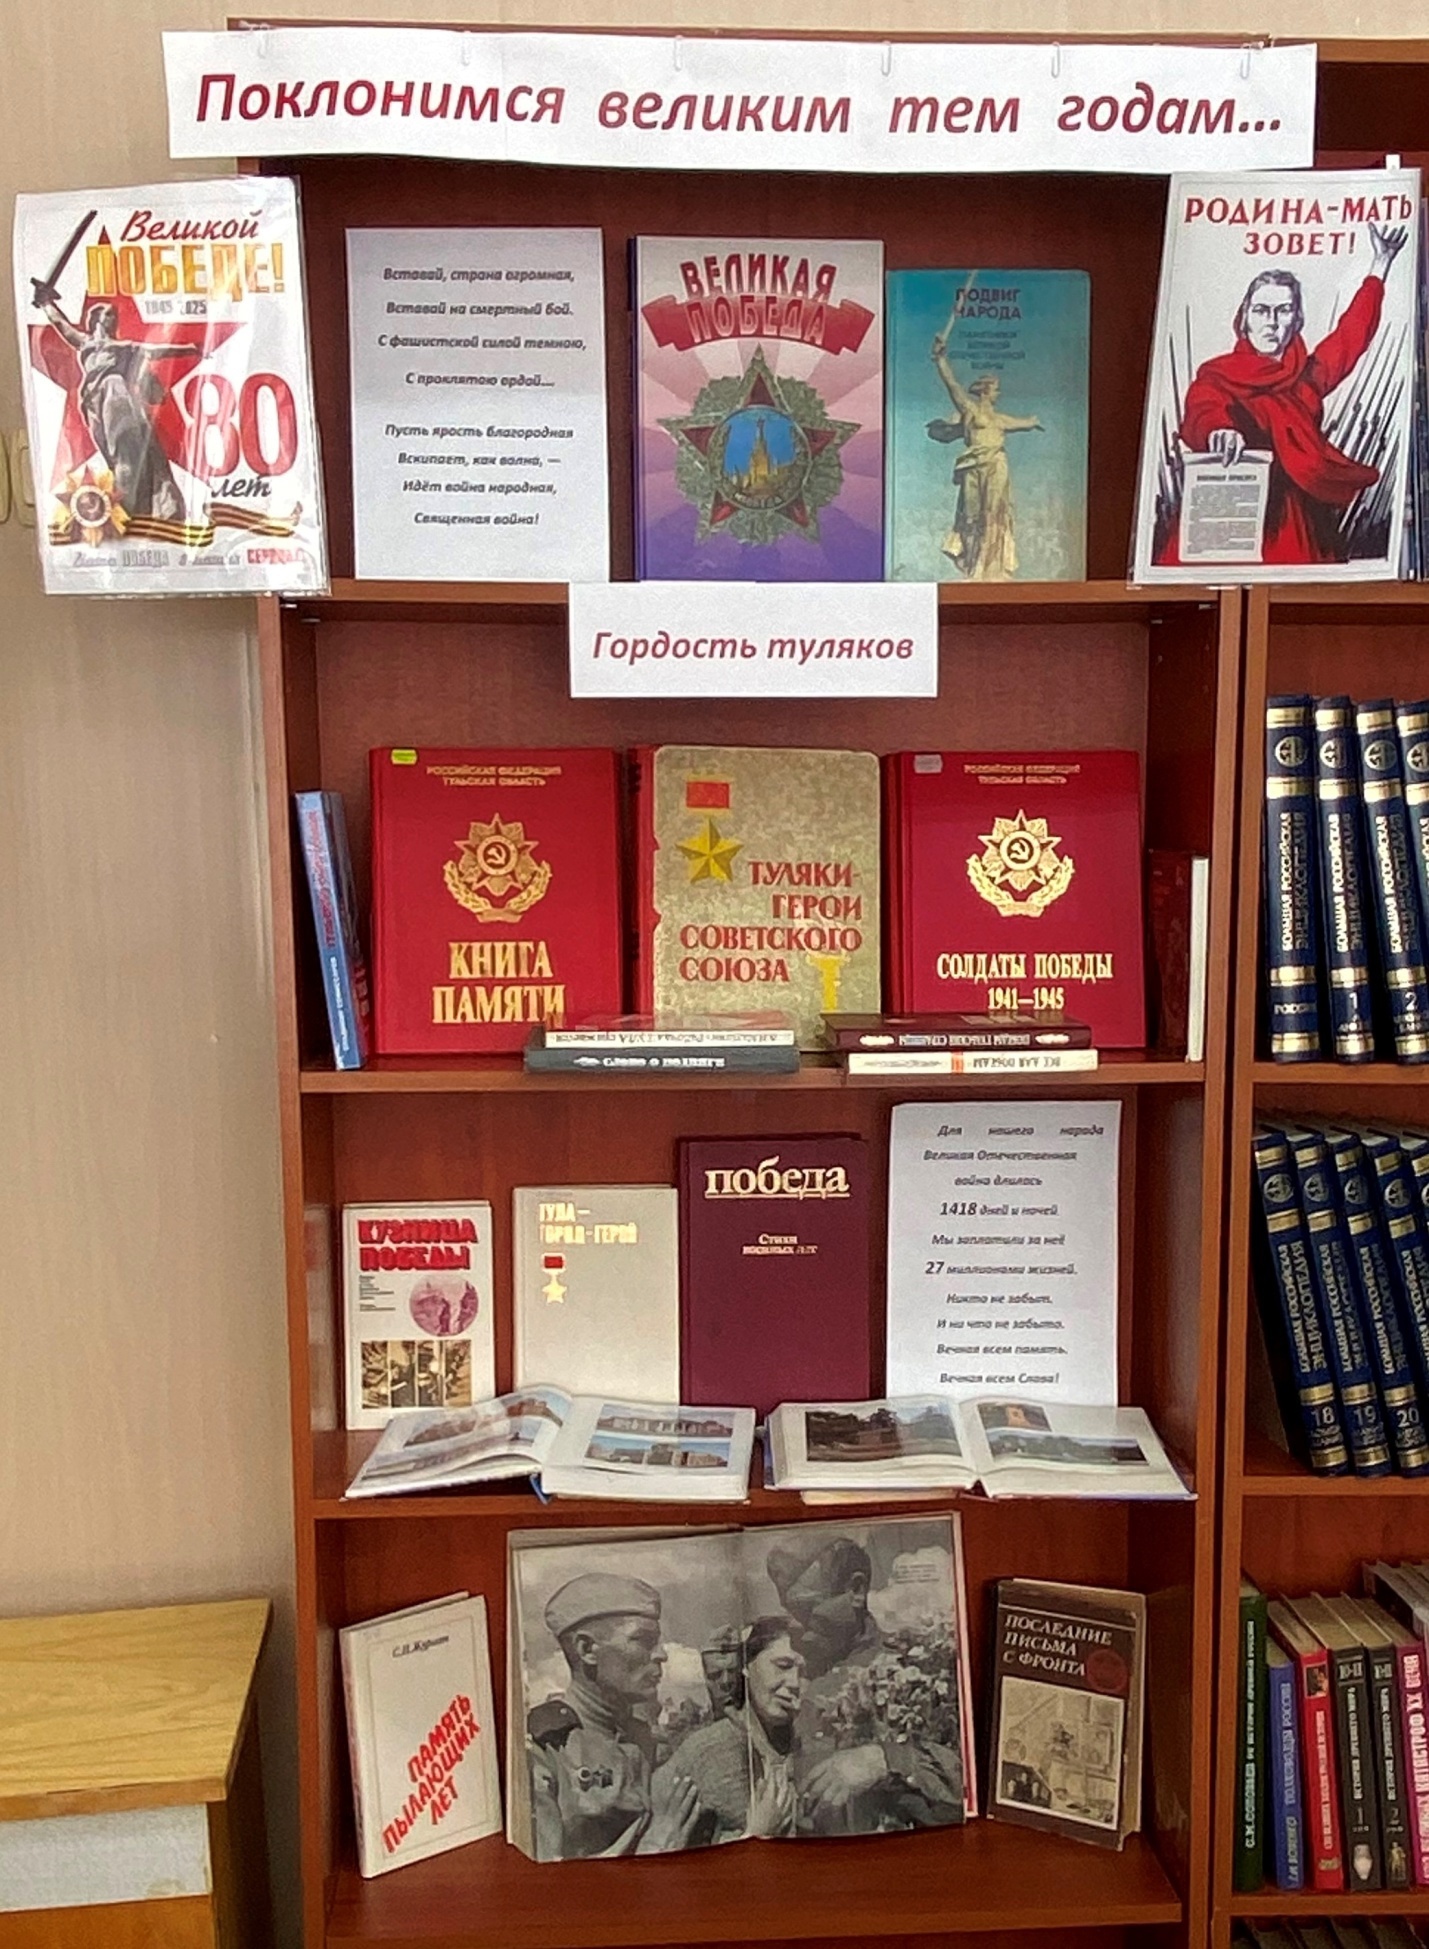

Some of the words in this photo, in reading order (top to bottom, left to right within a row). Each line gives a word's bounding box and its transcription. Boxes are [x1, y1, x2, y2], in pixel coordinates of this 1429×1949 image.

[196, 73, 565, 124] Поклонимся
[598, 90, 850, 134] великим
[888, 95, 1021, 133] тем
[1056, 81, 1283, 135] годам...
[1184, 194, 1413, 226] РОДИНА-МАТЬ
[120, 209, 263, 242] Великой
[1243, 232, 1356, 255] ЗОВЕТ!
[85, 243, 285, 301] ПОБЕДЕ!
[383, 268, 447, 282] Вставай,
[450, 270, 501, 283] страна
[505, 270, 575, 283] огромная,
[680, 253, 837, 303] ВЕЛИКАЯ
[956, 288, 1021, 304] ПОДВИГ
[386, 302, 446, 315] Вставай
[450, 305, 466, 315] на
[469, 303, 542, 317] смертный
[545, 302, 574, 315] бой.
[686, 295, 826, 345] ПОБЕДА
[378, 334, 387, 346] С
[389, 334, 479, 349] фашистской
[482, 336, 521, 348] силой
[406, 372, 415, 384] С
[417, 373, 498, 387] проклятою
[183, 371, 297, 477] 80
[385, 424, 429, 438] Пусть
[432, 426, 483, 438] ярость
[486, 426, 574, 440] благородная
[398, 453, 469, 467] Вскипает,
[472, 455, 496, 466] как
[499, 456, 543, 467] волна,
[211, 477, 272, 498] лет
[403, 480, 442, 492] Идёт
[445, 482, 485, 493] война
[488, 483, 557, 495] народная,
[414, 513, 491, 526] Священная
[493, 513, 540, 525] война!
[593, 630, 757, 665] Гордость
[767, 637, 914, 665] туляков
[1280, 813, 1292, 890] РОССИЙСКАЯ
[1329, 814, 1344, 892] РОССИЙСКАЯ
[1376, 816, 1394, 894] РОССИЙСКАЯ
[772, 894, 862, 920] ГЕРОИ
[680, 924, 862, 951] СОВЕТСКОГО
[449, 941, 553, 979] КНИГА
[679, 956, 790, 982] СОЮЗА
[937, 953, 1027, 983] СОЛДАТЫ
[1034, 953, 1113, 983] ПОБЕДЫ
[432, 985, 565, 1024] ПАМЯТИ
[1350, 993, 1357, 1009] 1
[1405, 992, 1417, 1011] 2
[937, 1125, 963, 1137] Для
[988, 1127, 1035, 1136] нашего
[1060, 1124, 1104, 1137] народа
[923, 1150, 974, 1161] Великая
[977, 1150, 1078, 1161] Отечественная
[704, 1155, 850, 1200] победа
[954, 1175, 990, 1186] война
[993, 1175, 1043, 1186] длилась
[939, 1202, 977, 1216] 1418
[979, 1204, 1009, 1216] дней
[1011, 1207, 1019, 1215] и
[358, 1219, 479, 1244] КУЗНИЦА
[540, 1222, 638, 1244] ГОРОД-ГЕРОЙ
[758, 1233, 798, 1245] Стихи
[931, 1234, 954, 1245] Мы
[957, 1236, 1025, 1245] заплатили
[1028, 1236, 1041, 1245] за
[359, 1246, 470, 1271] ПОБЕДЫ
[742, 1245, 794, 1255] военных
[925, 1261, 945, 1275] 27
[946, 1264, 1025, 1275] миллионами
[1028, 1263, 1078, 1275] жизней.
[1278, 1244, 1300, 1318] РОССИЙСКАЯ
[1319, 1244, 1342, 1318] РОССИЙСКАЯ
[1360, 1247, 1382, 1319] РОССИЙСКАЯ
[946, 1293, 988, 1304] Никто
[990, 1295, 1005, 1304] не
[1290, 1241, 1327, 1371] ЭНЦИКЛОПЕДИЯ
[937, 1319, 946, 1329] И
[949, 1320, 964, 1329] ни
[967, 1320, 992, 1329] что
[995, 1320, 1010, 1329] не
[937, 1344, 980, 1355] Вечная
[983, 1346, 1012, 1355] всем
[940, 1373, 983, 1384] Вечная
[985, 1374, 1015, 1384] всем
[1018, 1372, 1060, 1384] Слава!
[1311, 1407, 1335, 1426] 18
[1354, 1406, 1376, 1426] 19
[1396, 1408, 1419, 1427] 20
[1004, 1613, 1113, 1646] ПОСЛЕДНИЕ
[1004, 1631, 1077, 1656] ПИСЬМА
[1002, 1652, 1015, 1663] С
[1018, 1652, 1086, 1677] ФРОНТА
[1404, 1655, 1421, 1688] ВЕКА
[407, 1694, 472, 1783] ПАМЯТЬ
[1409, 1713, 1429, 1793] КАТАСТРОФ
[382, 1713, 481, 1854] ПЫЛАЮЩИХ
[430, 1776, 459, 1825] ЛЕТ
